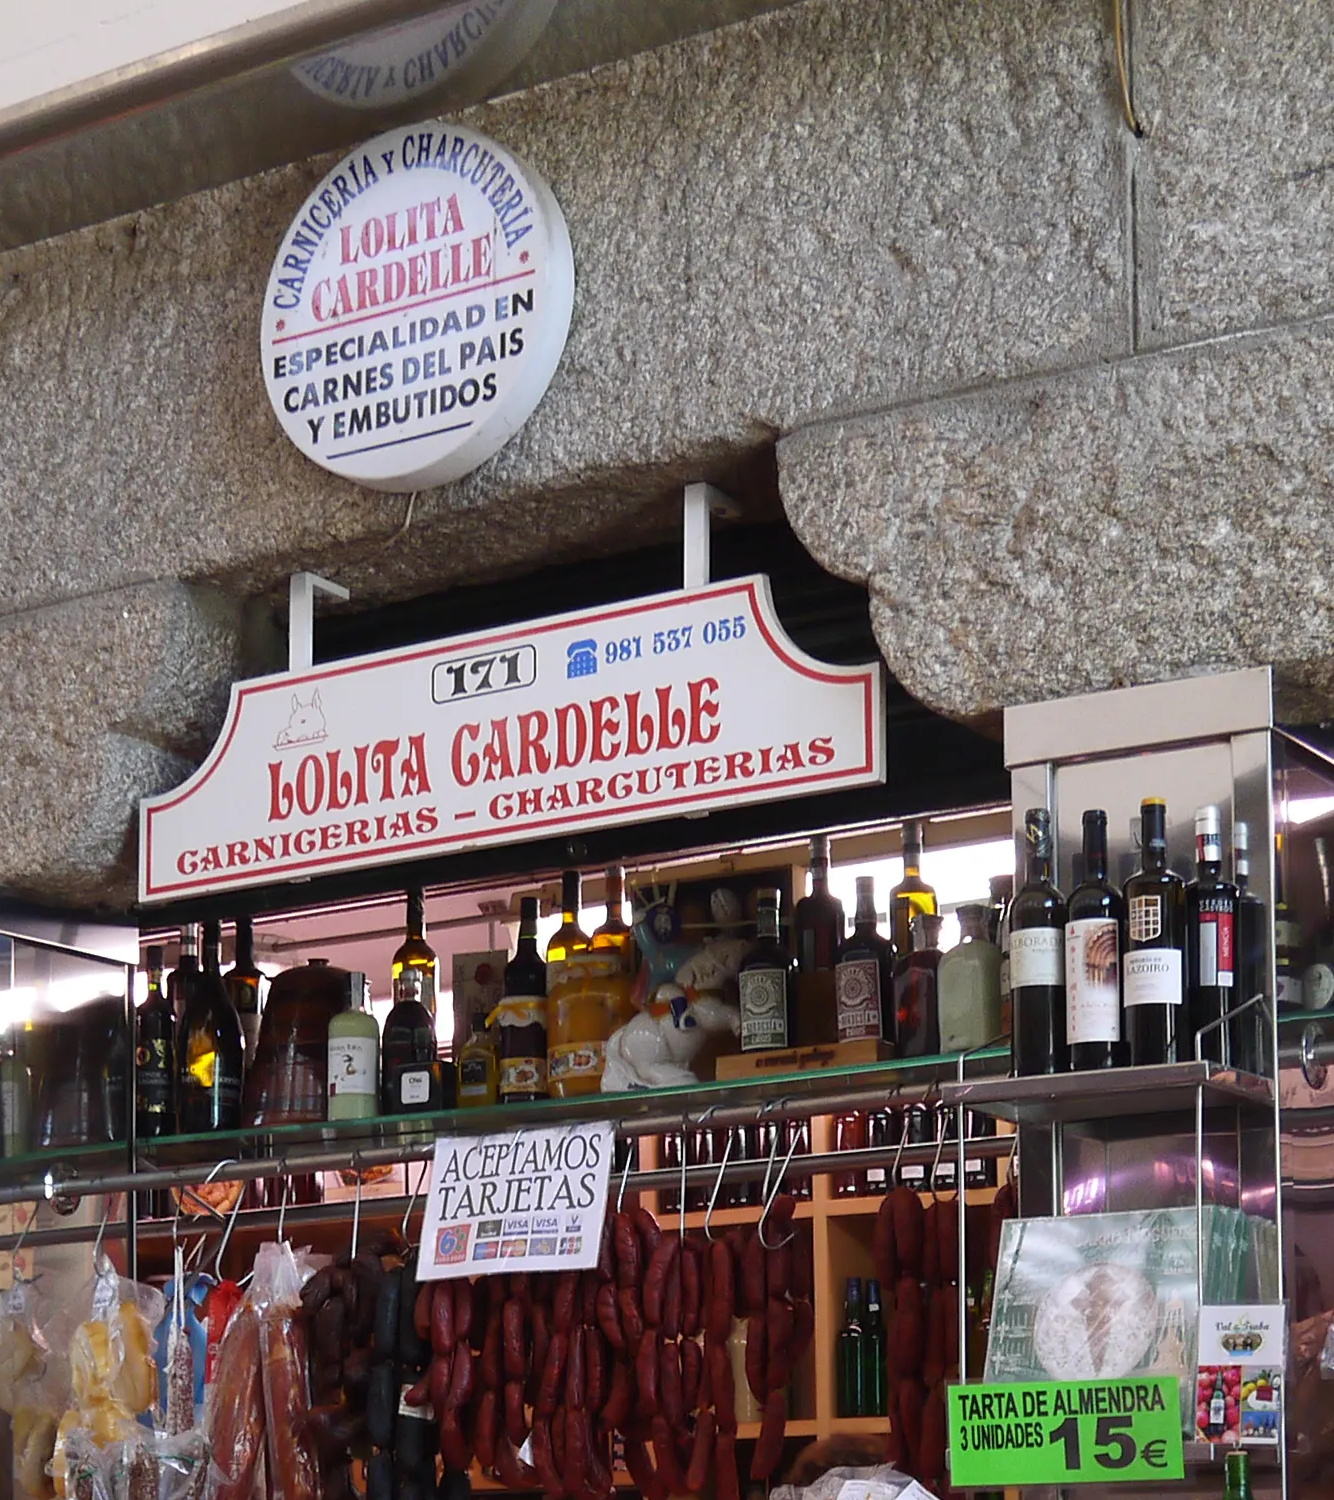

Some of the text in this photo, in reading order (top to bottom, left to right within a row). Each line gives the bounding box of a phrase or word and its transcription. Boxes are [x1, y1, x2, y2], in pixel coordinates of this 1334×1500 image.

[273, 132, 535, 310] CARNICERÍA Y CHARCUTERÍA
[339, 192, 466, 266] LOLITA
[310, 233, 493, 323] CARDELLE
[273, 288, 535, 379] ESPECIALIDAD EN
[283, 327, 525, 414] CARNES DEL PAIS
[307, 373, 498, 445] Y EMBUTIDOS
[604, 615, 747, 665] 981 537 055
[445, 652, 524, 699] 171
[267, 676, 722, 824] LOLITA CARDELLE
[176, 735, 838, 877] CARNICERIAS CHARCUTERIAS
[440, 1134, 602, 1184] ACEPTAMOS
[439, 1173, 597, 1221] TARJETAS
[507, 1219, 529, 1230] VISA
[535, 1217, 559, 1228] VISA
[958, 1384, 1165, 1421] TARTA DE ALMENDRA
[960, 1426, 969, 1450] 3
[971, 1421, 1044, 1450] UNIDADES
